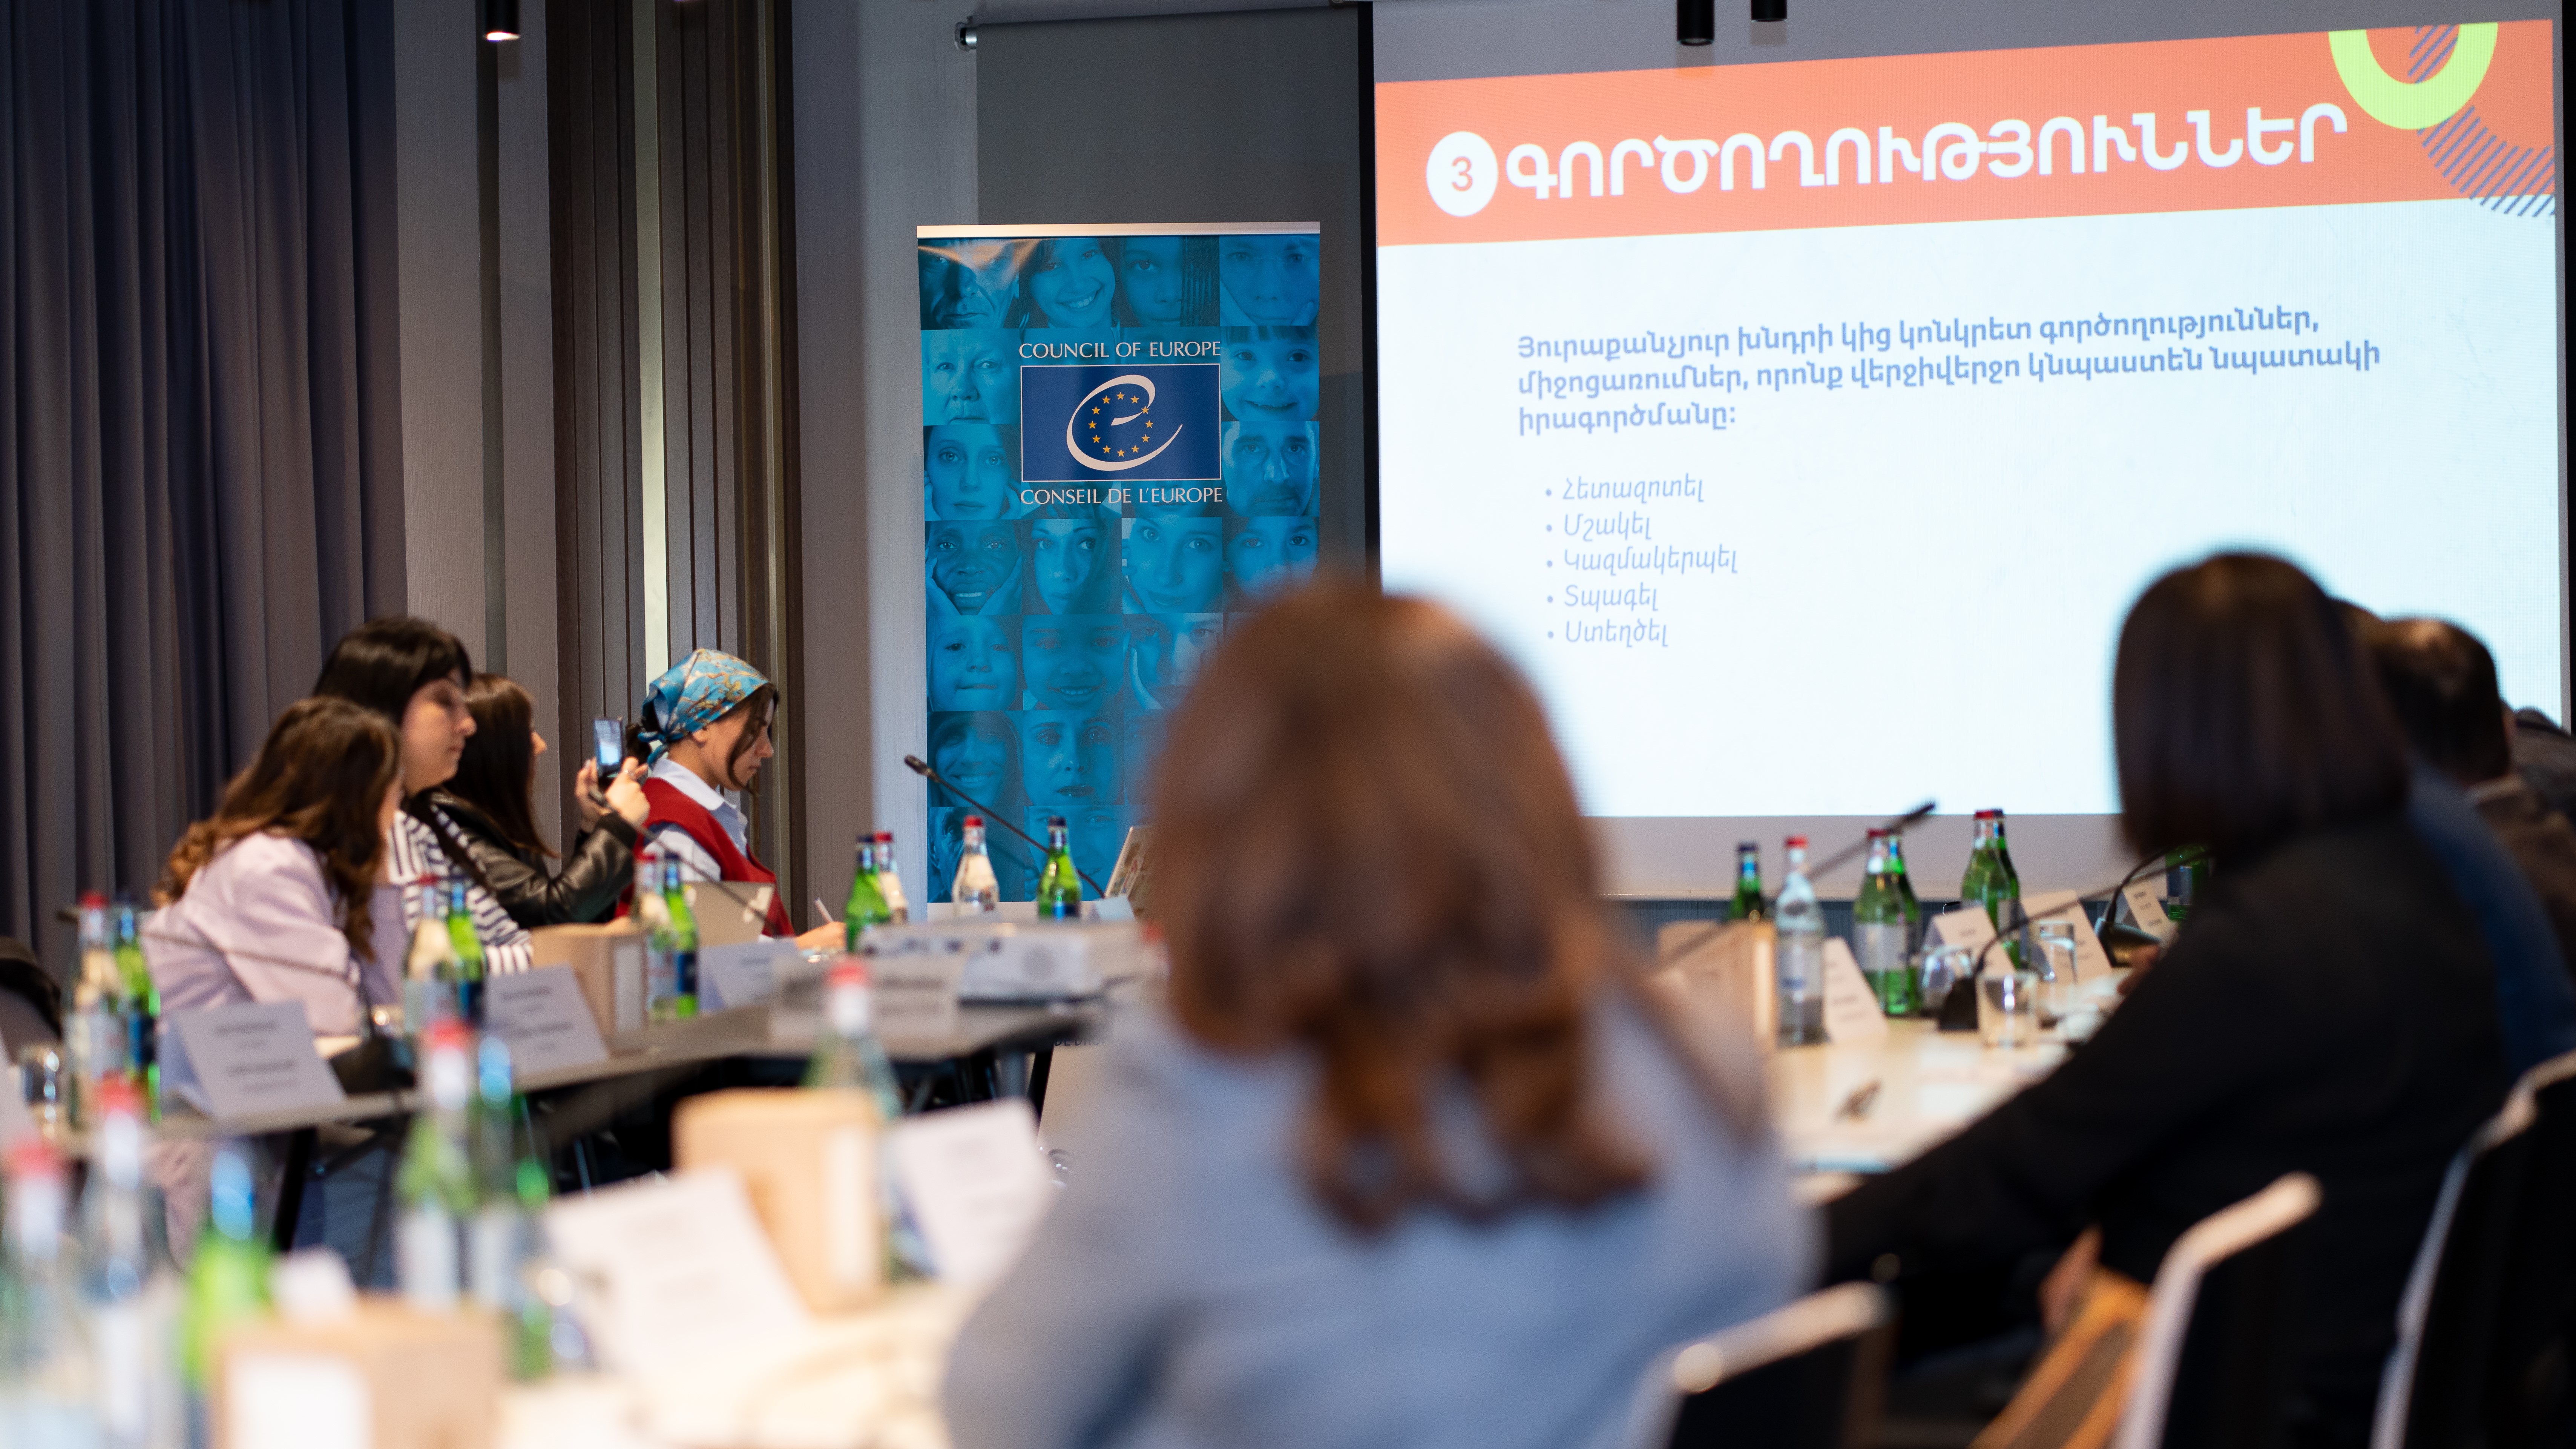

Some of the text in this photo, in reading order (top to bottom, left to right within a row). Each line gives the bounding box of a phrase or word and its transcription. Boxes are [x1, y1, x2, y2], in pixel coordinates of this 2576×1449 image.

[1451, 102, 2348, 200] 3 ԳՈՐԾՈՂՈՒԹՅՈՒՆՆԵՐ
[1518, 304, 2319, 363] Յուրաքանչյուր խնդրի կից կոնկրետ գործողություններ,
[1019, 341, 1221, 359] COUNCIL OF EUROPE
[1518, 339, 2380, 400] միջոցառումներ, որոնք վերջիվերջո կնպաստեն նպատակի
[1020, 487, 1222, 505] CONSEIL DE L'EUROPE
[1562, 473, 1704, 504] Հետազոտել
[1564, 510, 1652, 542] Մշակել
[1564, 543, 1738, 576] Կազմակերպել
[1566, 618, 1668, 648] Ստեղծել
